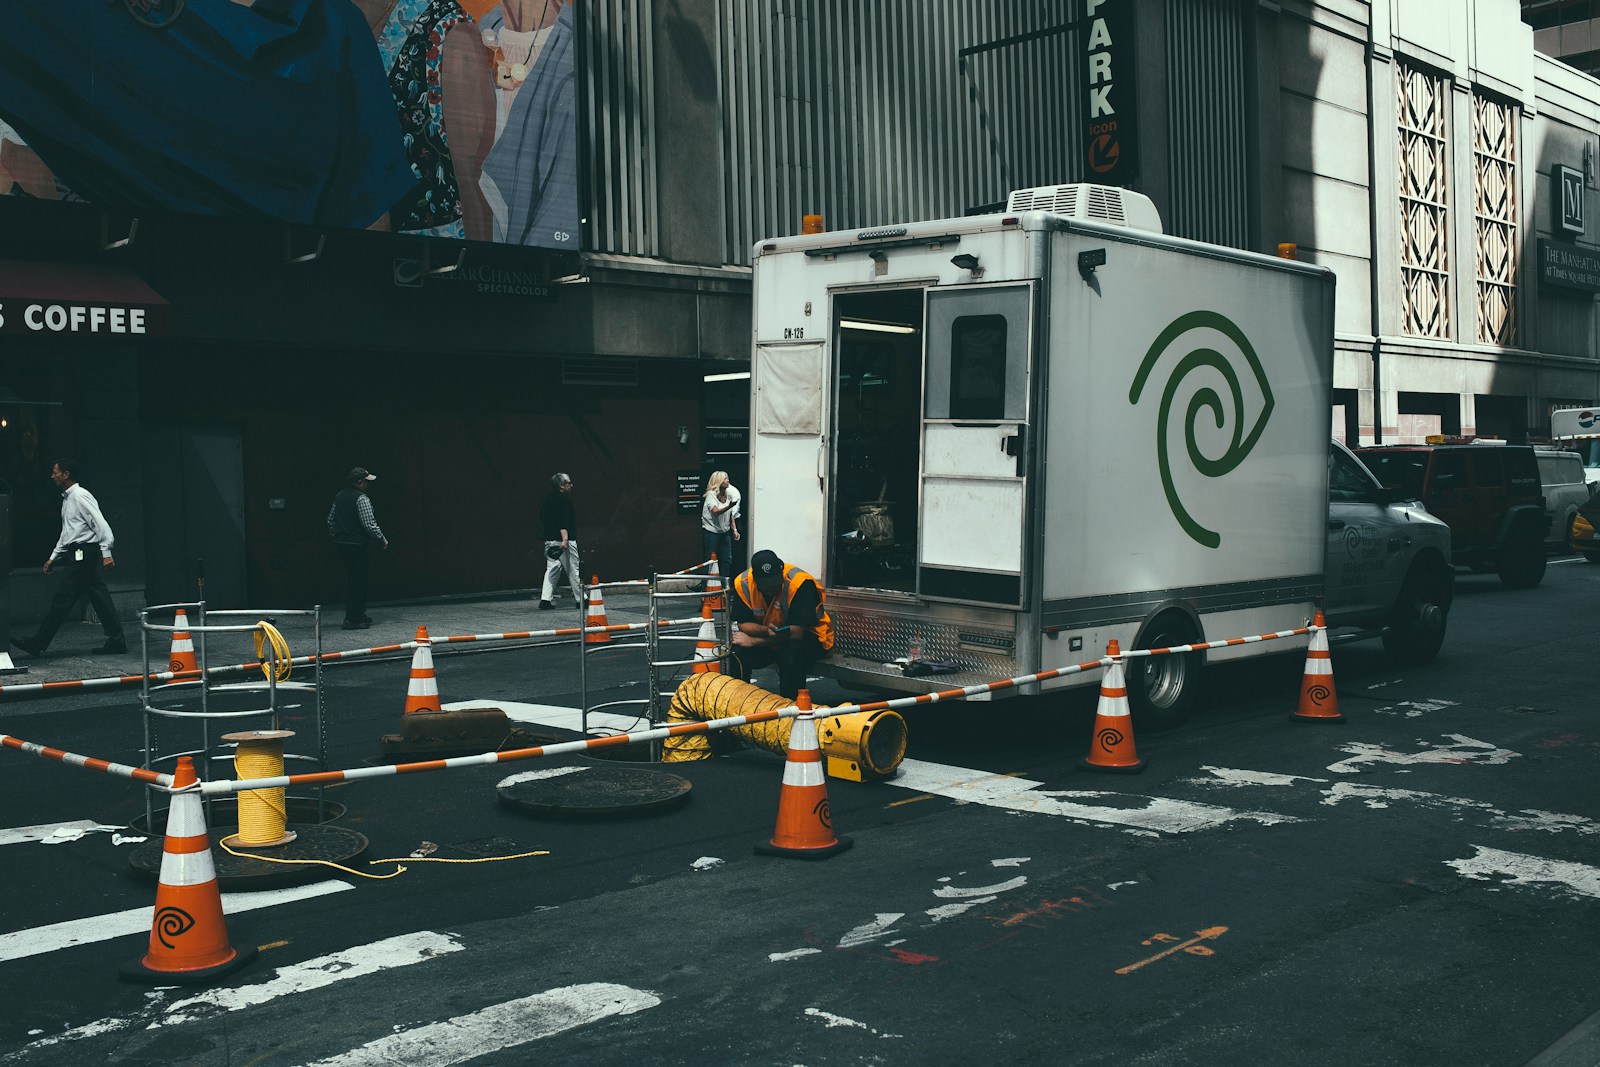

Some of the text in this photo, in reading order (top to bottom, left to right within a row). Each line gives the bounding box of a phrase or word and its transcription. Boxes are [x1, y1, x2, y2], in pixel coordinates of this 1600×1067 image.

[1088, 121, 1117, 135] icon
[1565, 178, 1582, 221] M
[1545, 246, 1559, 264] THE
[1552, 266, 1567, 279] TIMES
[1568, 270, 1586, 284] SQUARE
[478, 283, 548, 296] SPECTACOLOR
[24, 304, 146, 334] COFFEE
